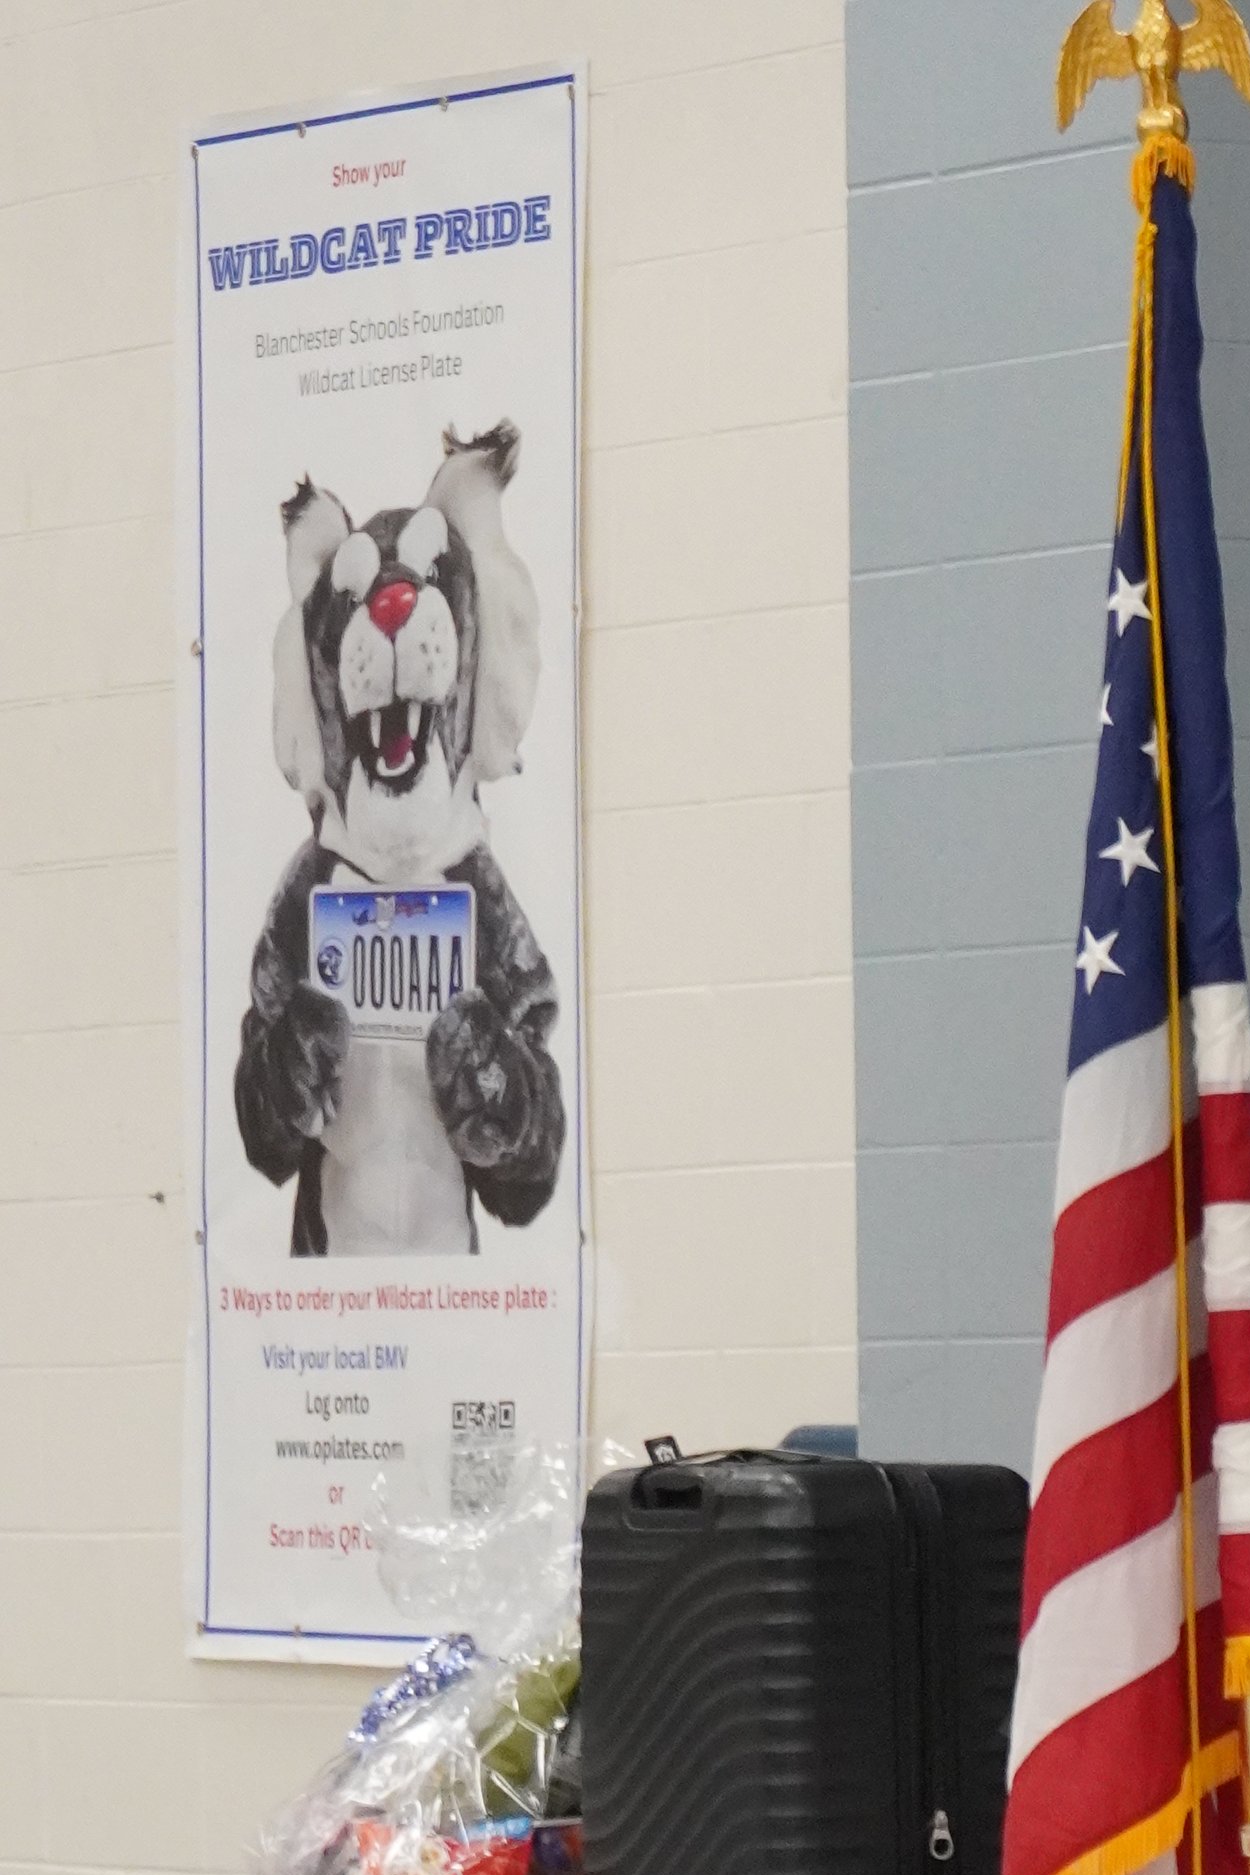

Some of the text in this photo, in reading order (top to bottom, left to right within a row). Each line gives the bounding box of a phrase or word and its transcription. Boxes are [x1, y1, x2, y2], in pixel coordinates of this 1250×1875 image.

[332, 159, 407, 188] Show your
[208, 195, 551, 291] WILDCAT PRIDE
[255, 302, 504, 358] Blanchester Schools Foundation
[299, 354, 463, 397] Wildcat License Plate
[220, 1287, 229, 1311] 3
[233, 1287, 272, 1318] Ways
[276, 1289, 292, 1311] to
[297, 1286, 334, 1311] order
[339, 1291, 371, 1317] your
[376, 1284, 432, 1310] Wildcat
[438, 1284, 500, 1310] License
[262, 1344, 408, 1377] Visit your local BMV
[306, 1390, 369, 1421] Log onto
[275, 1434, 405, 1465] www.oplates.com
[329, 1486, 344, 1504] or
[270, 1523, 304, 1548] Scan
[309, 1523, 335, 1549] this
[340, 1525, 360, 1556] QR
